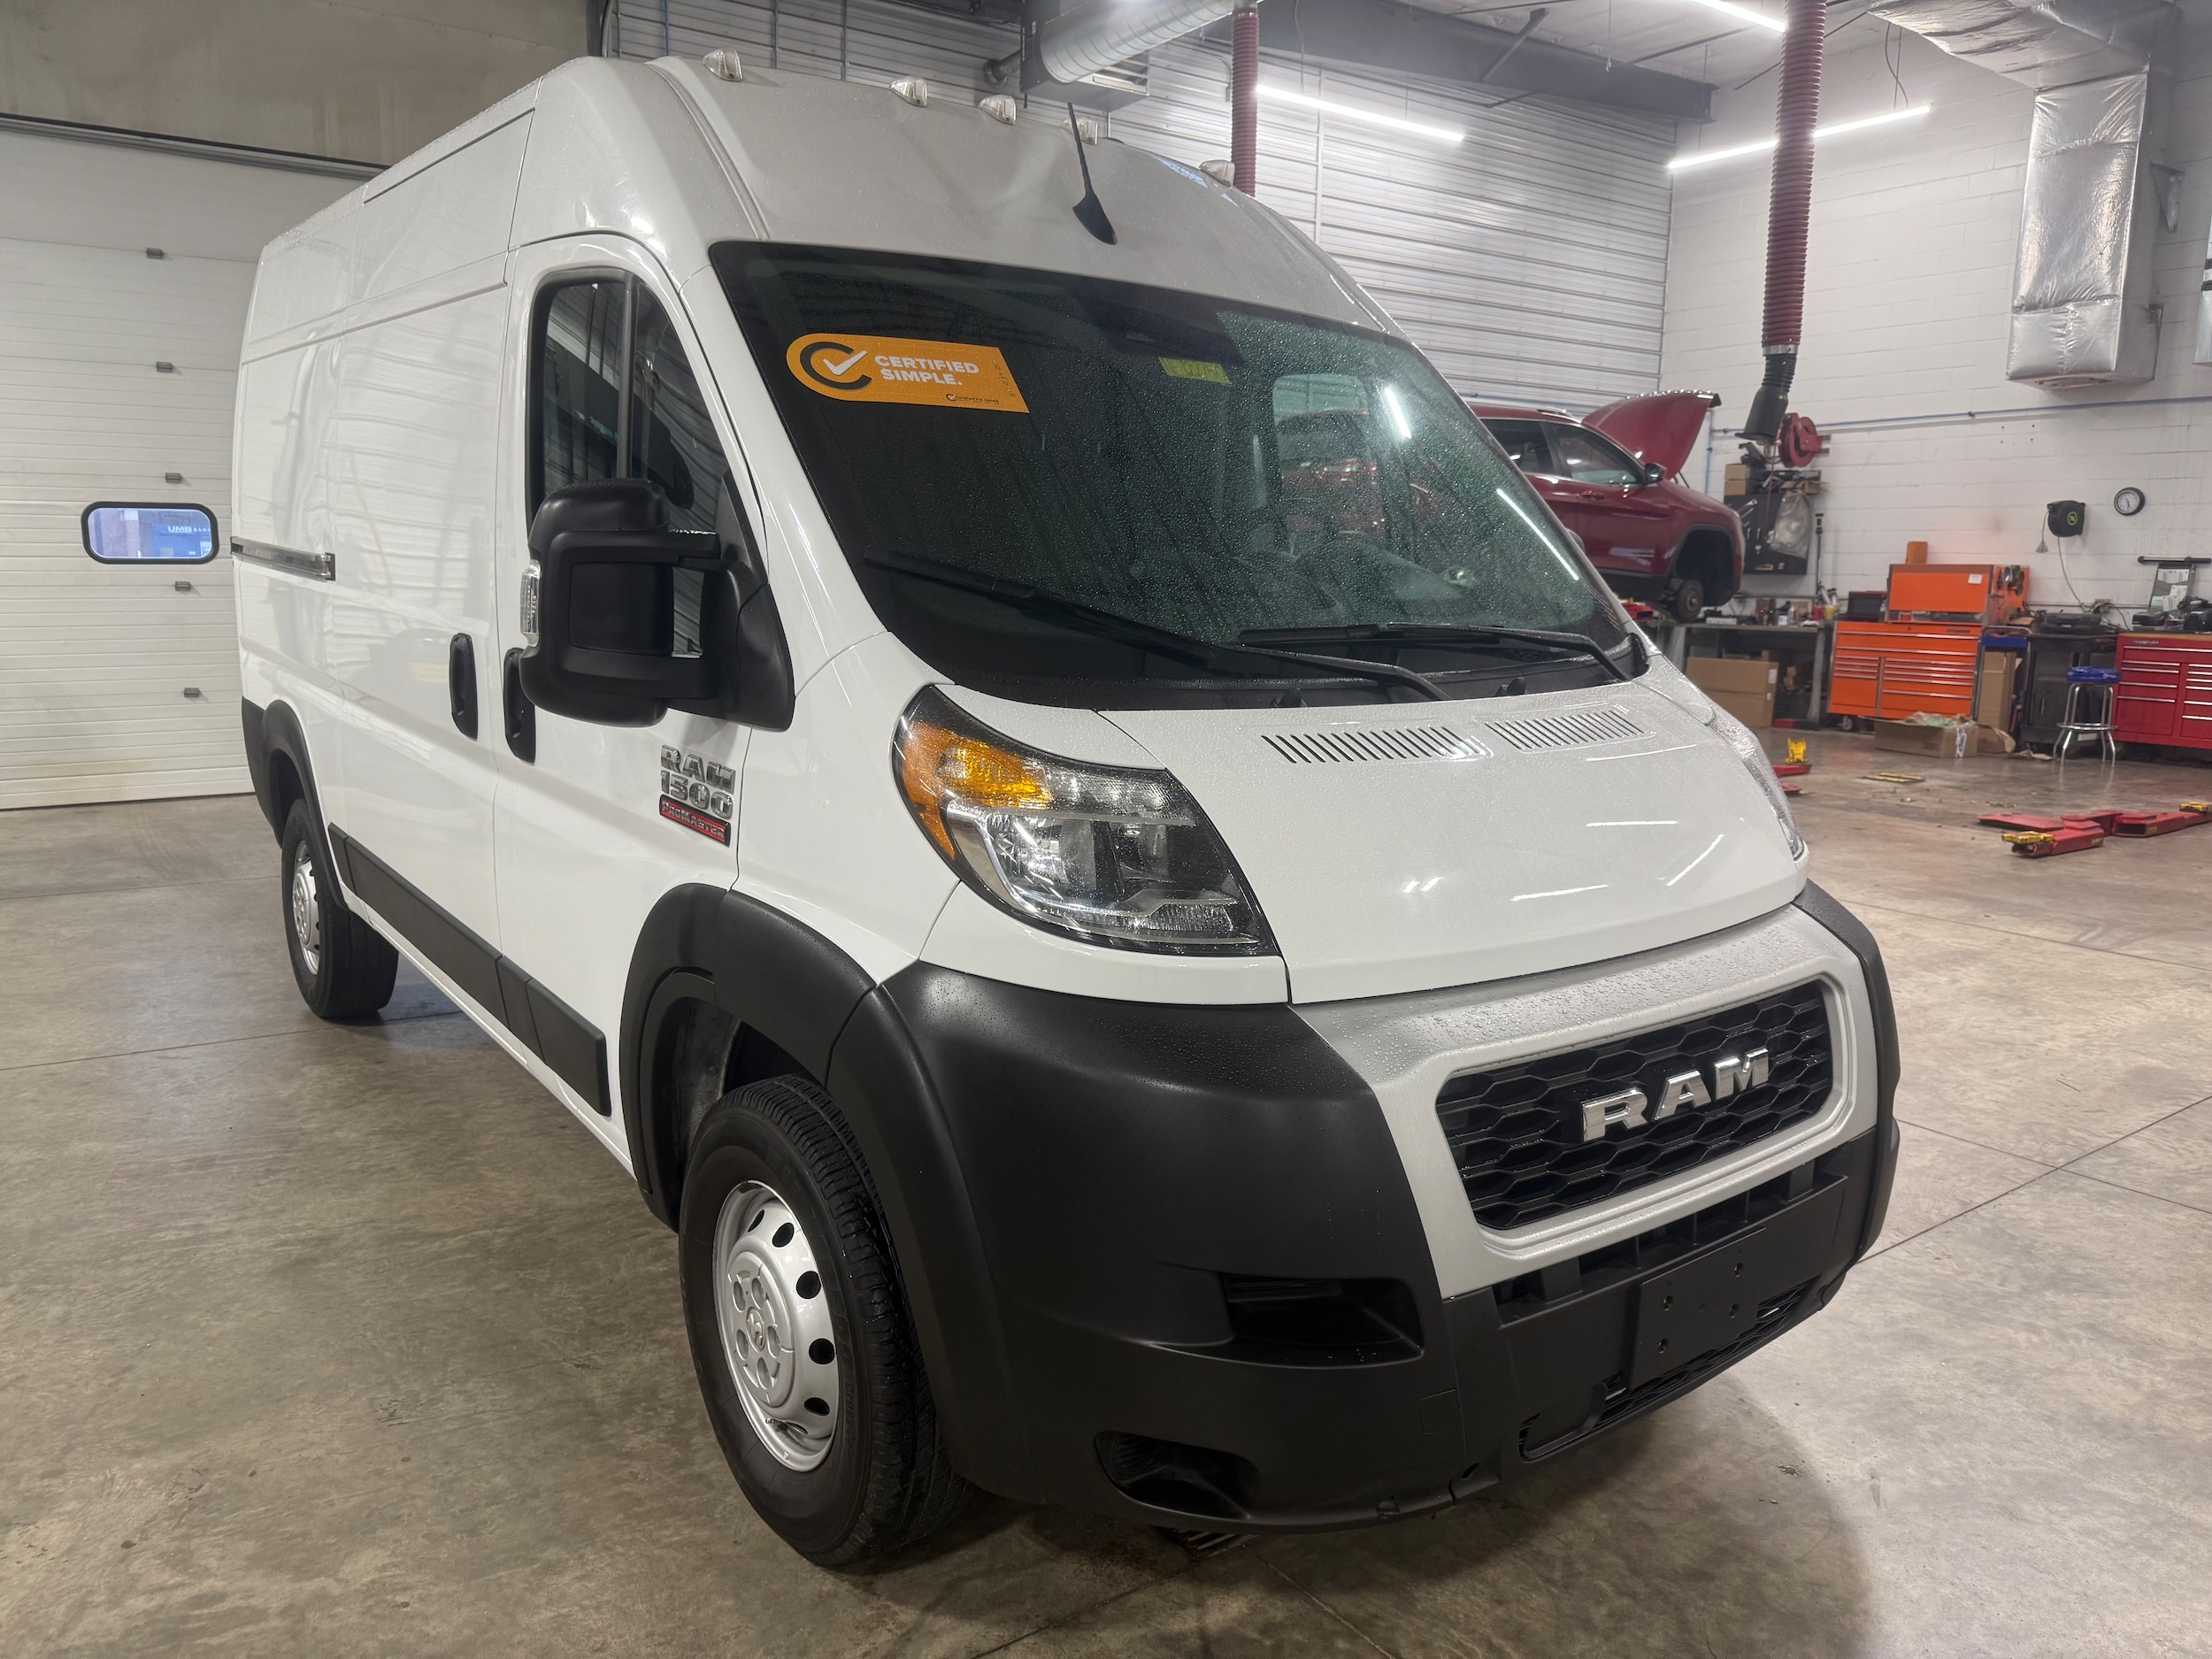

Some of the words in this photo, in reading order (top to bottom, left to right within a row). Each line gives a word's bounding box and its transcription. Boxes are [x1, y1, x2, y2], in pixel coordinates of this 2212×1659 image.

[874, 355, 979, 374] CERTIFIED
[880, 368, 964, 386] SIMPLE.
[660, 744, 735, 795] RAM
[660, 769, 733, 820] 1500
[1580, 1048, 1770, 1143] RAM
